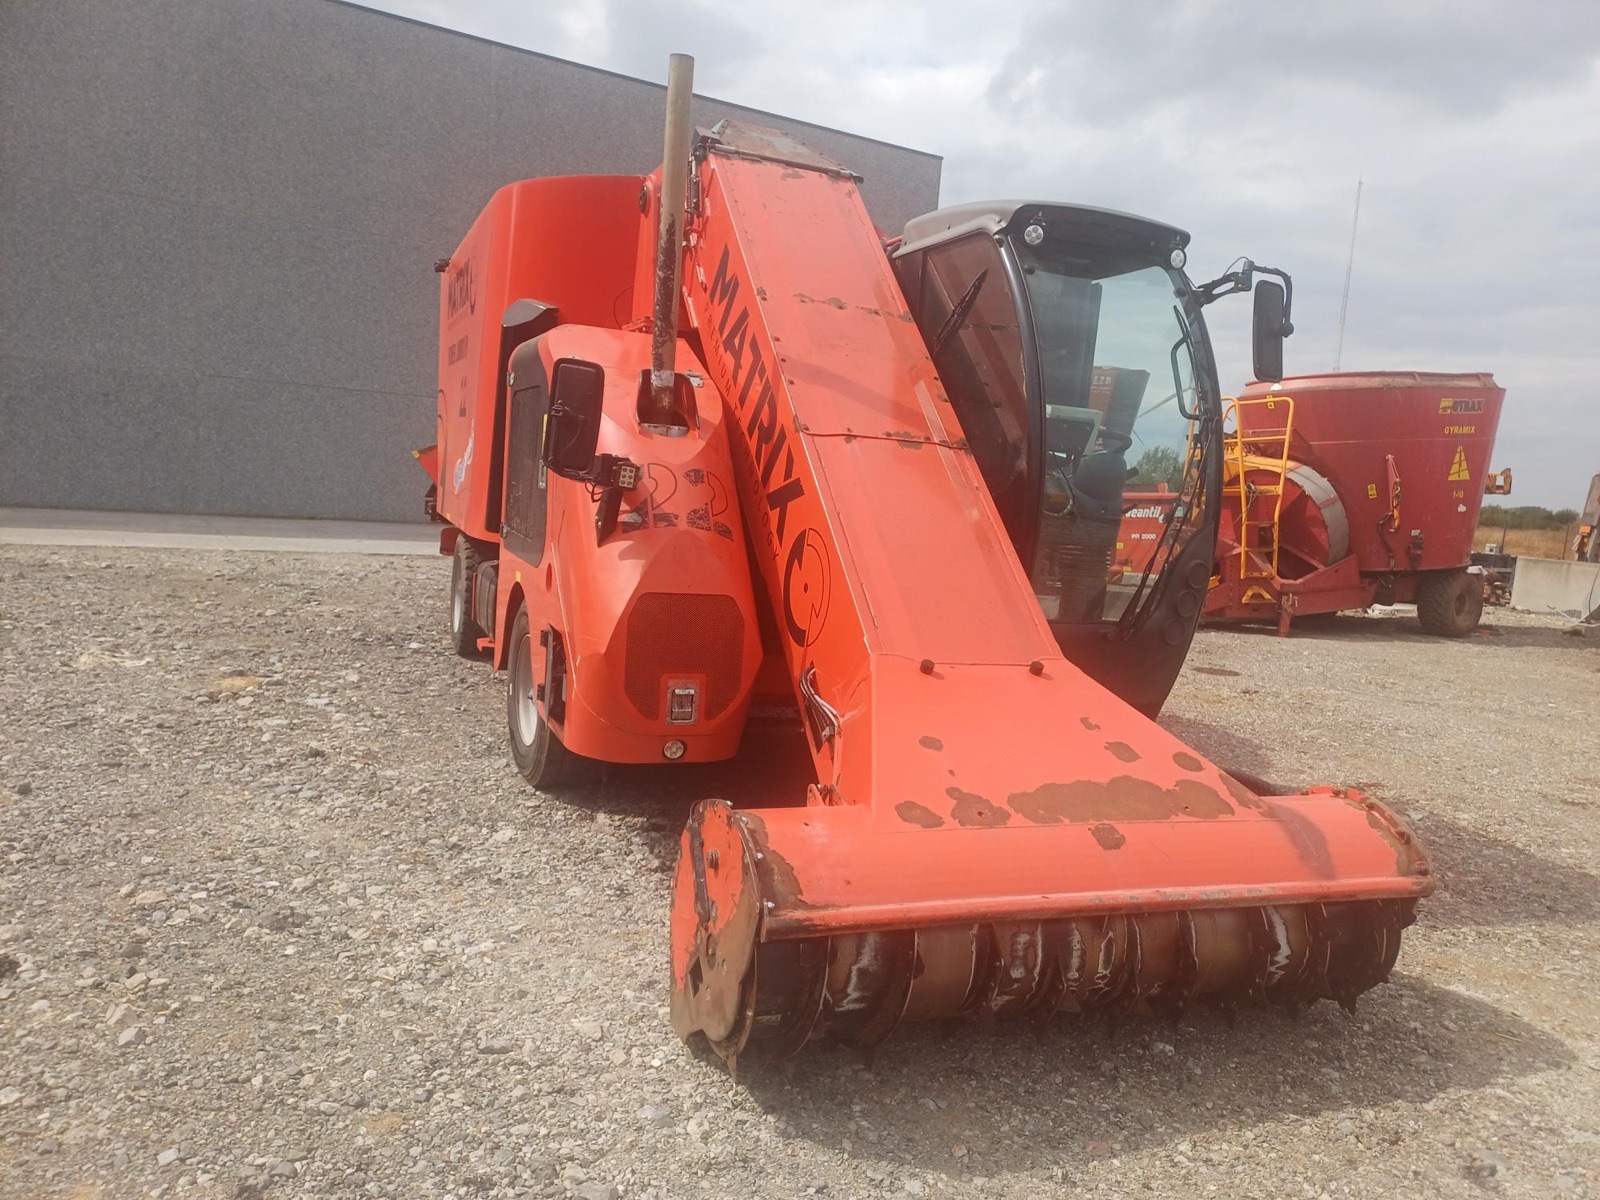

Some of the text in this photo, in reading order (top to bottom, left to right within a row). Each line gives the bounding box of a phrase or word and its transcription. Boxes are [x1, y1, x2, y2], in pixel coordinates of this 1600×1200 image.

[703, 302, 779, 560] PREMIUM TECHNOLOGY
[709, 242, 804, 547] MATRIX
[1444, 426, 1476, 434] GYRAMIX
